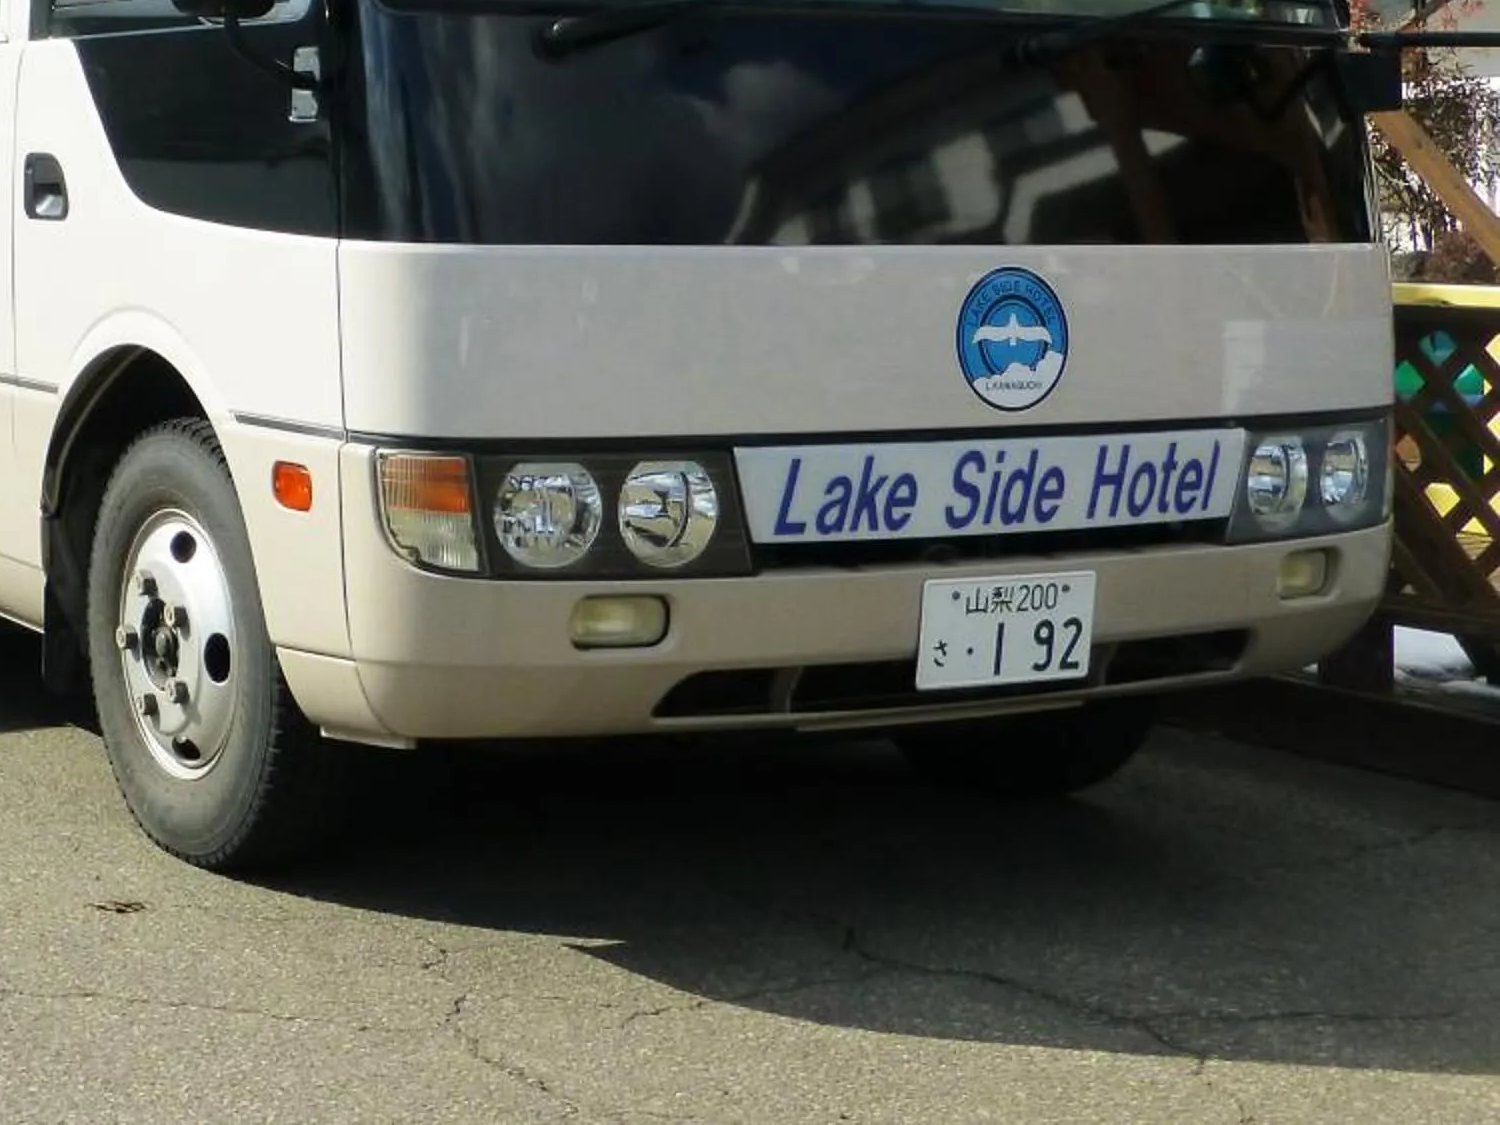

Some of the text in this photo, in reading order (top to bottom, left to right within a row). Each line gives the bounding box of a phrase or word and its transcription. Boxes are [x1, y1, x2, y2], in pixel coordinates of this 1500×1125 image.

[774, 440, 1221, 536] Lake Side Hotel
